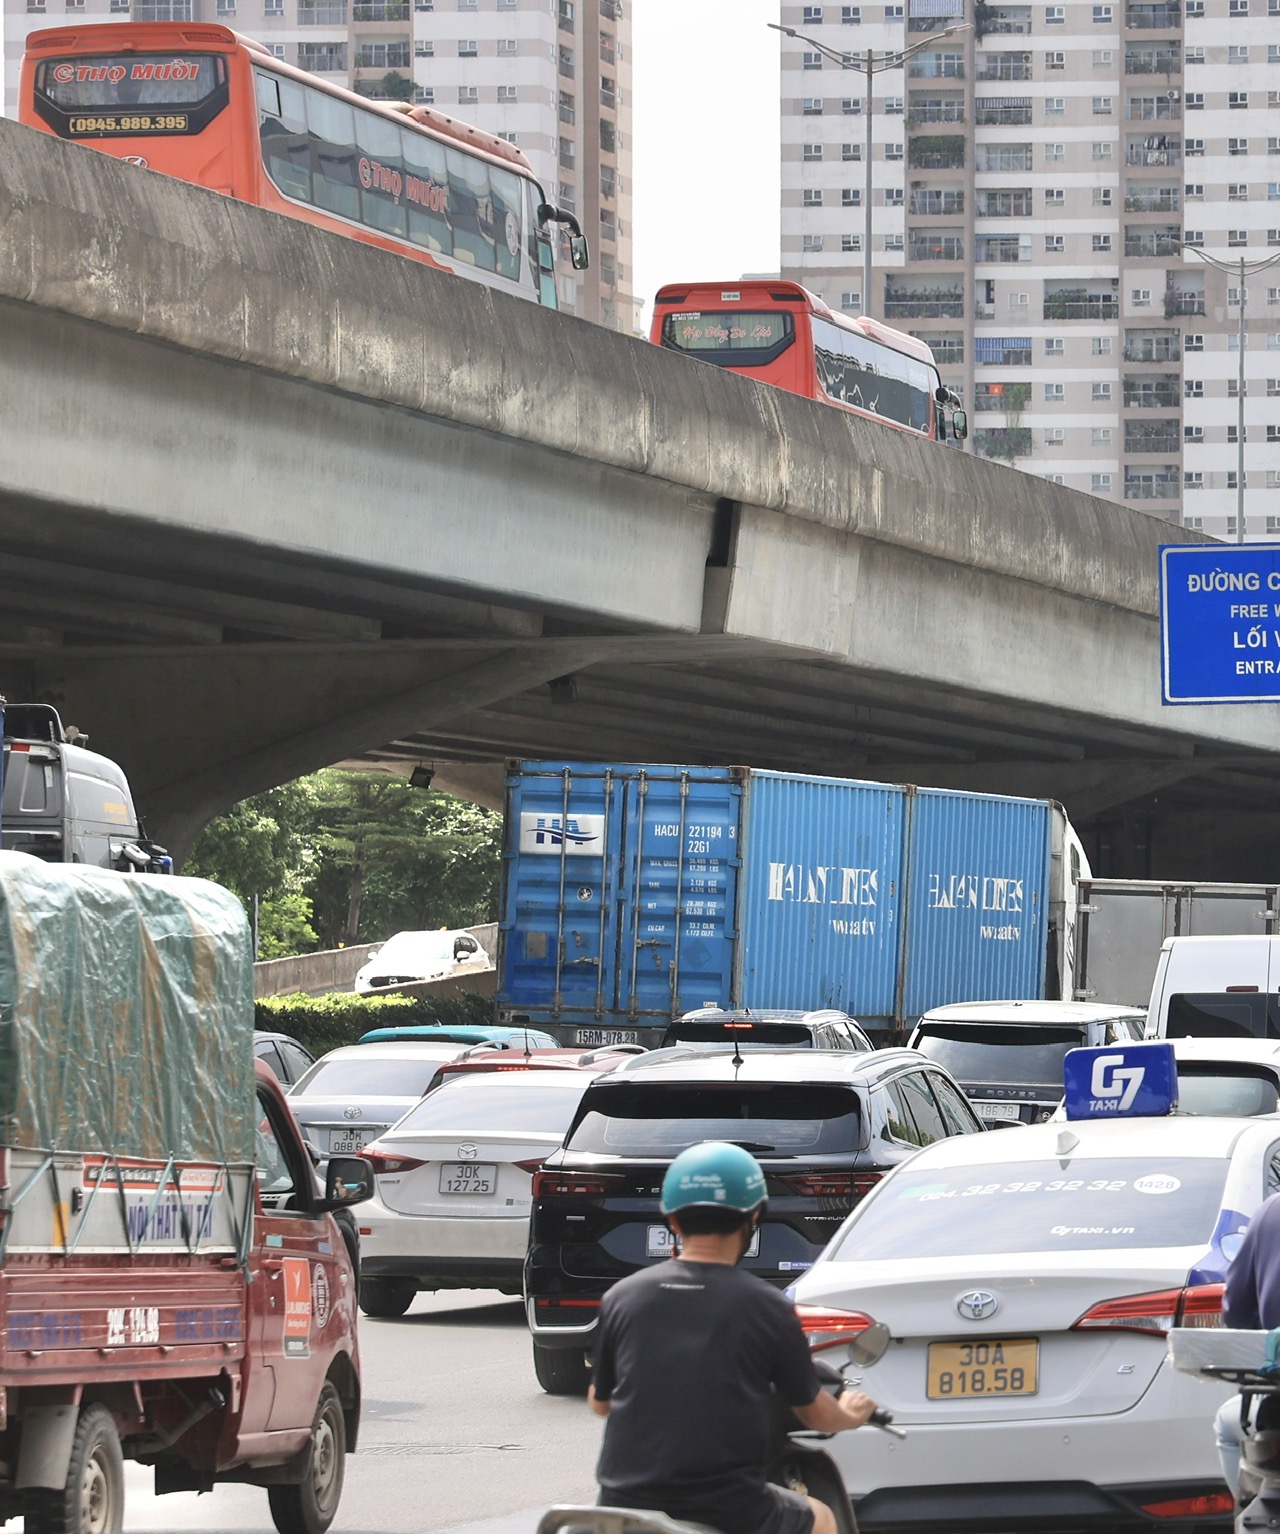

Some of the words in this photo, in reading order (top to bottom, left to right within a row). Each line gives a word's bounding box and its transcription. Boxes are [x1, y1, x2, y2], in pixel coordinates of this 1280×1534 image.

[75, 65, 126, 84] THỌ
[75, 116, 186, 131] 0945.989.395
[1187, 567, 1260, 592] ĐƯỜNG
[1230, 604, 1268, 618] FREE
[1233, 625, 1267, 649] LỐI
[654, 824, 679, 837] HACU
[688, 825, 722, 839] 221194
[728, 826, 736, 839] 3
[687, 840, 710, 854] 22G1
[578, 1030, 636, 1044] 15RM-078.28
[1091, 1055, 1145, 1110] G7
[986, 1088, 1037, 1098] ROVER
[1089, 1100, 1118, 1111] TAXI
[456, 1165, 479, 1178] 30K
[447, 1179, 489, 1192] 127.25
[961, 1183, 1001, 1196] 32
[1002, 1182, 1042, 1194] 32
[1044, 1180, 1084, 1192] 32
[1086, 1180, 1127, 1192] 32
[1137, 1180, 1176, 1189] 1428
[959, 1343, 1005, 1366] 30A
[1116, 1364, 1135, 1374] E
[939, 1367, 1025, 1394] 818.58
